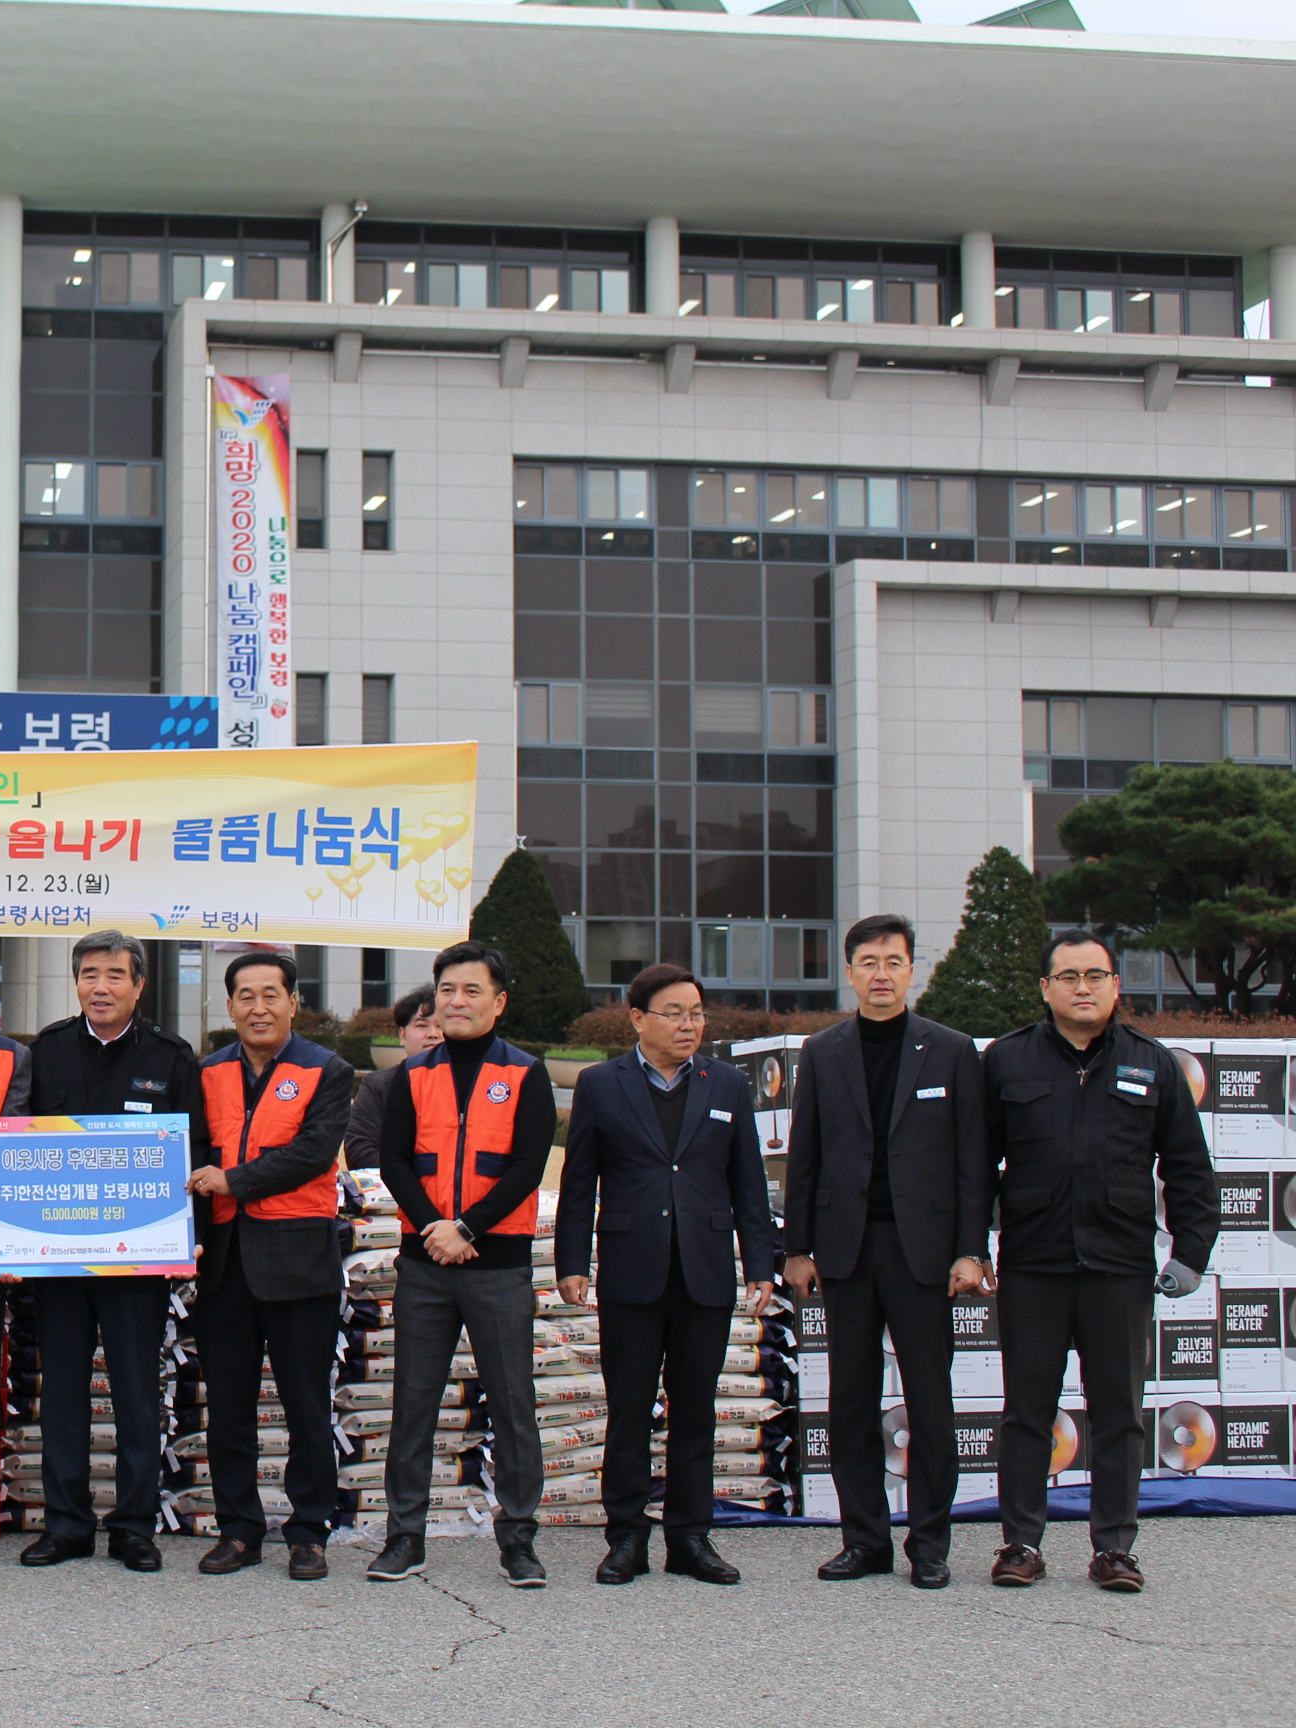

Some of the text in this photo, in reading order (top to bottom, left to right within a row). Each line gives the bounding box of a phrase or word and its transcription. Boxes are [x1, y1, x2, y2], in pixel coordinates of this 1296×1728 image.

[231, 489, 254, 573] 2020
[268, 517, 287, 585] 나눔으로
[227, 583, 258, 626] 나눔
[269, 593, 288, 645] 행복한
[269, 652, 288, 688] 보령
[19, 712, 110, 751] 보령
[227, 722, 256, 748] 성
[171, 806, 400, 870] 물품나눔식
[6, 874, 34, 892] 12.
[44, 872, 111, 895] 23.(월)
[201, 910, 259, 932] 보령시
[1220, 1070, 1260, 1084] CERAMIC
[1220, 1084, 1255, 1097] HEATER
[108, 1121, 121, 1129] 도시
[124, 1120, 143, 1128] 행복한
[2, 1146, 165, 1171] 이웃사랑 후원물품 전달
[103, 1181, 171, 1200] 보령사업처
[1220, 1188, 1262, 1200] CERAMIC
[1220, 1201, 1256, 1214] HEATER
[14, 1246, 36, 1256] 보령시
[1226, 1304, 1268, 1318] CERAMIC
[1226, 1318, 1262, 1331] HEATER
[1178, 1338, 1212, 1350] HEATER
[1172, 1351, 1212, 1364] CERAMIC
[556, 1392, 590, 1401] 가을햇쌀
[1227, 1421, 1269, 1435] CERAMIC
[955, 1429, 993, 1442] ERAMIC
[1227, 1436, 1263, 1448] HEATER
[547, 1514, 580, 1523] 가을햇쌀
